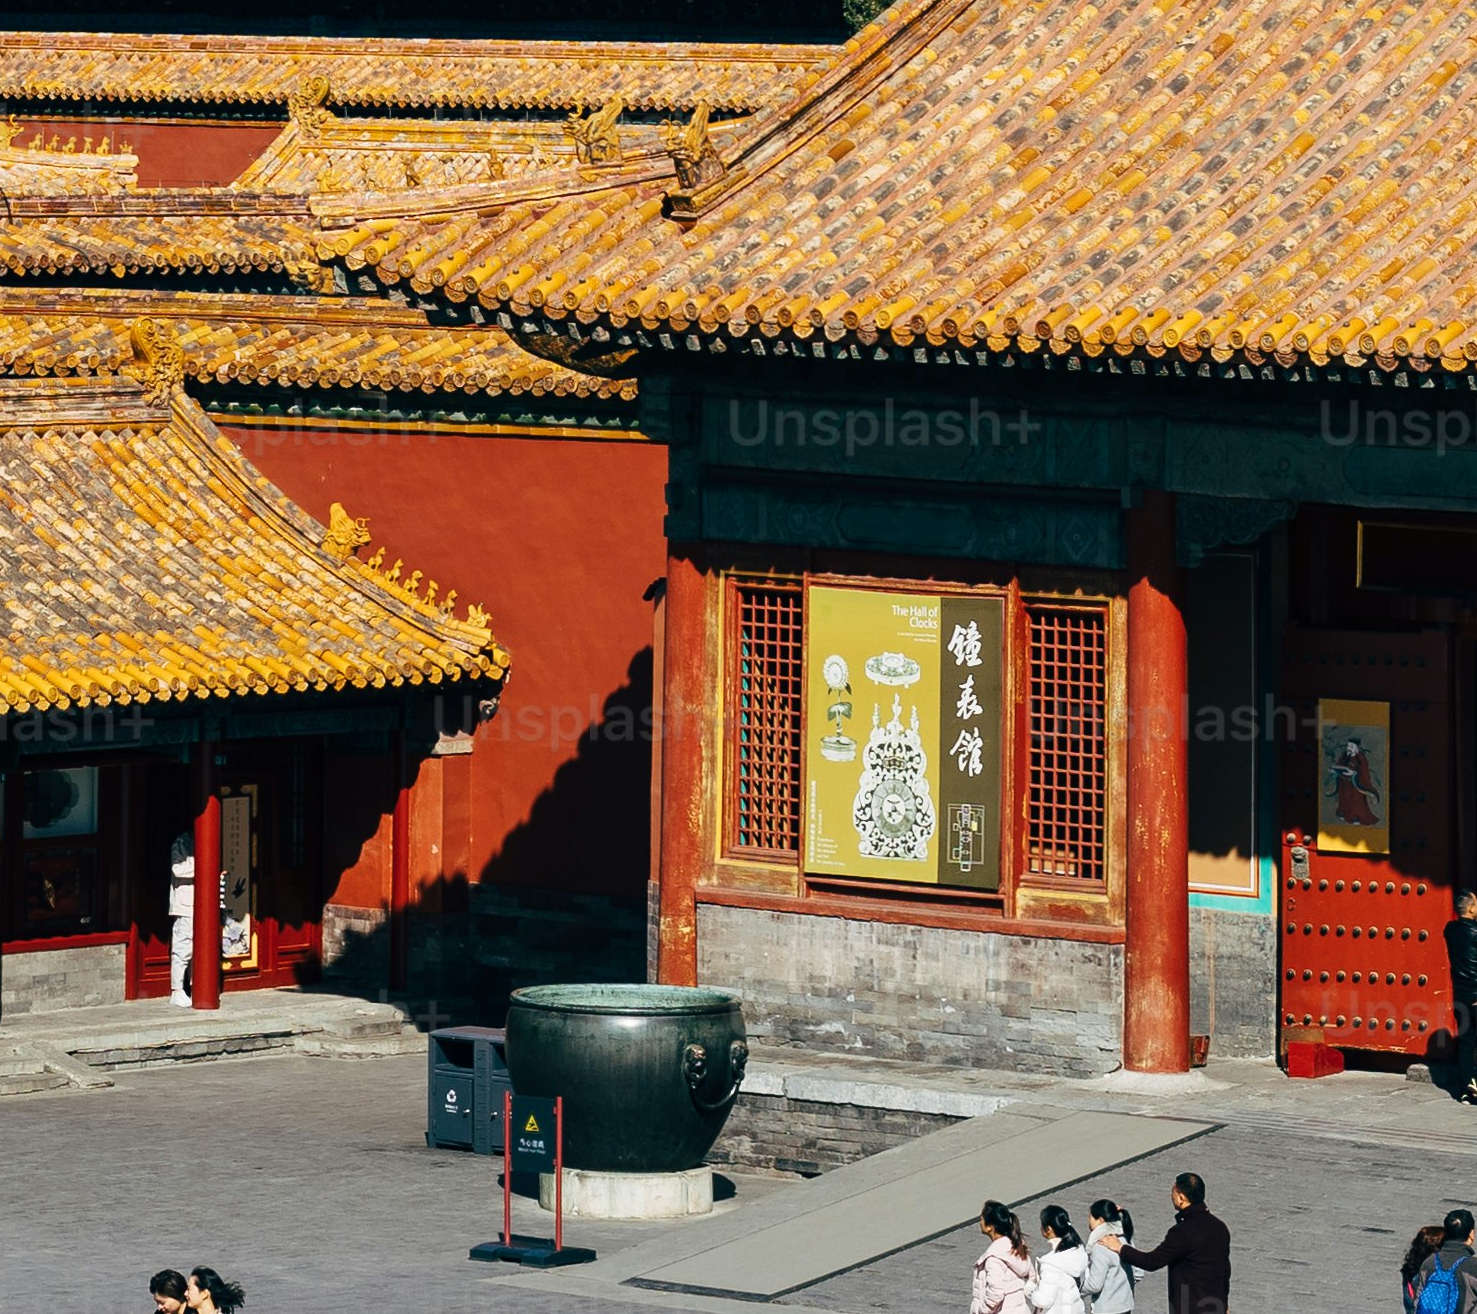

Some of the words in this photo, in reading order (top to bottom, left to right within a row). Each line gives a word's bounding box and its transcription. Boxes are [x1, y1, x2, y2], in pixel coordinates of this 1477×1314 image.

[892, 605, 909, 617] The
[910, 606, 928, 617] Hall
[928, 607, 939, 618] of
[909, 617, 938, 629] Clocks
